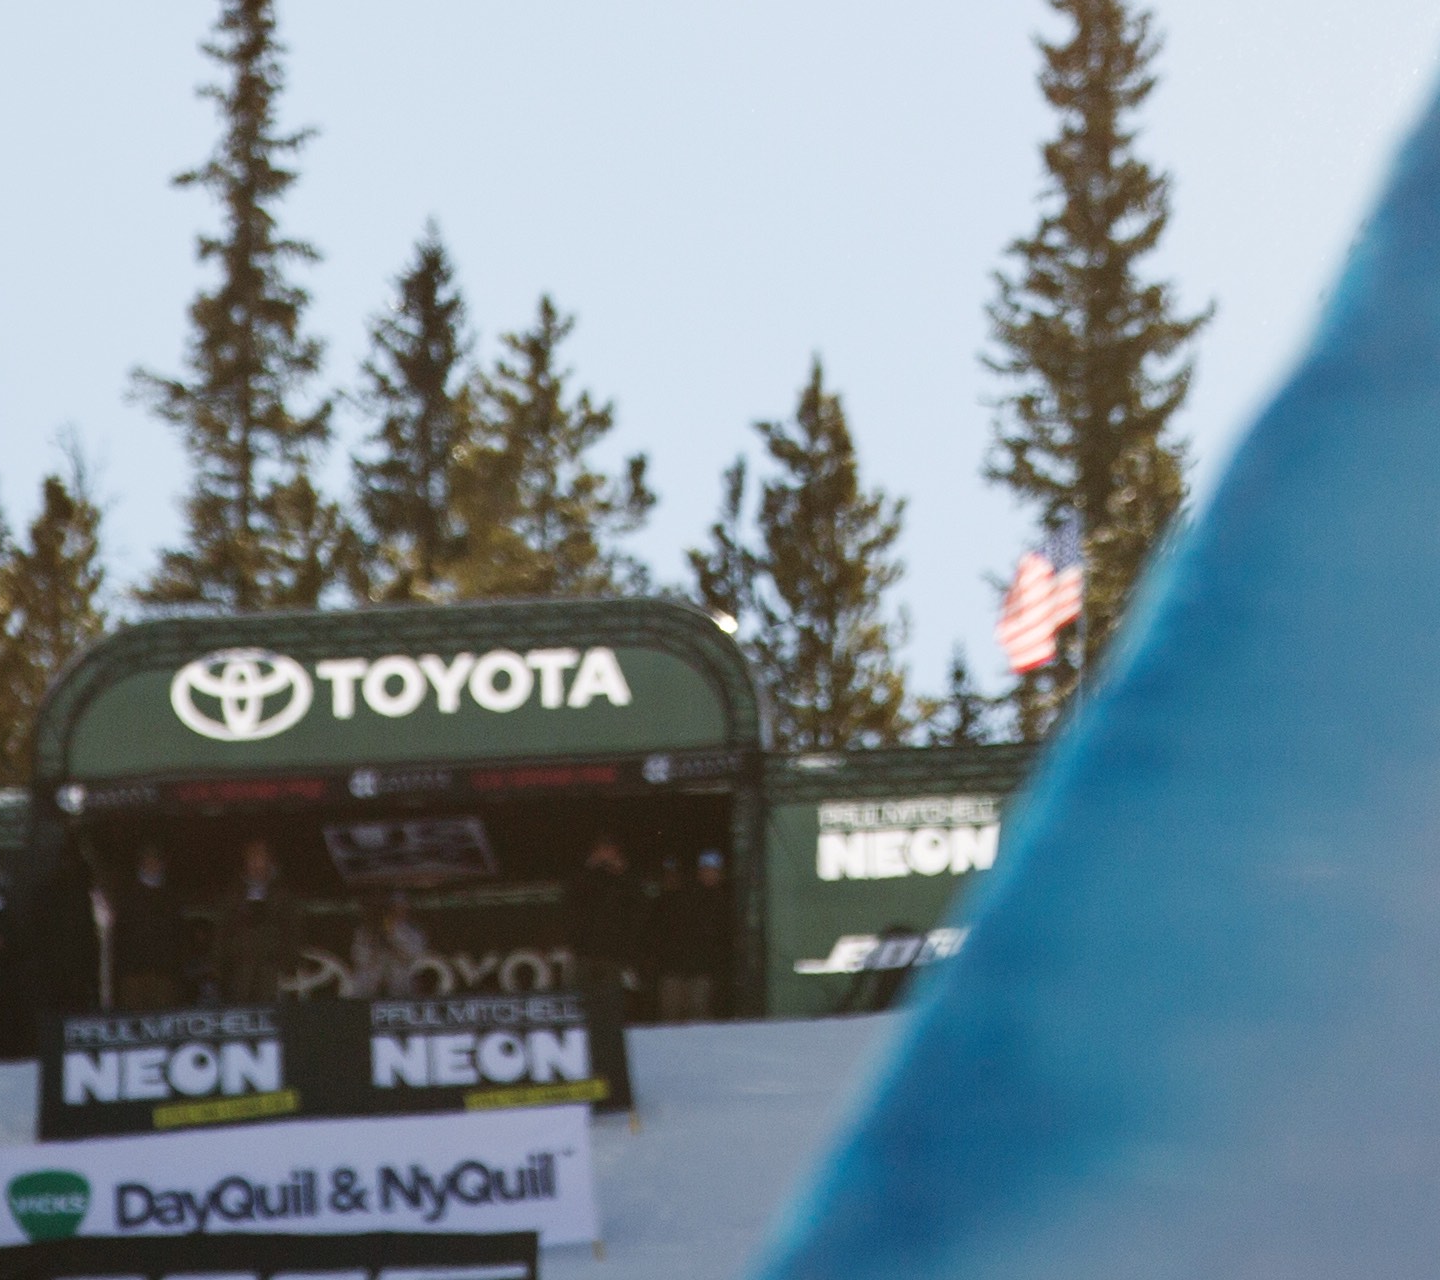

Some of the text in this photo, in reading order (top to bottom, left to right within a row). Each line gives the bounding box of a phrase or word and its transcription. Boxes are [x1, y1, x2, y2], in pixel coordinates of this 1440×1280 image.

[315, 646, 633, 720] TOYOTA
[816, 822, 1001, 881] NEON
[62, 1040, 284, 1106] NEON
[371, 1028, 591, 1088] NEON
[116, 1151, 557, 1233] DayQuil & NyQuil
